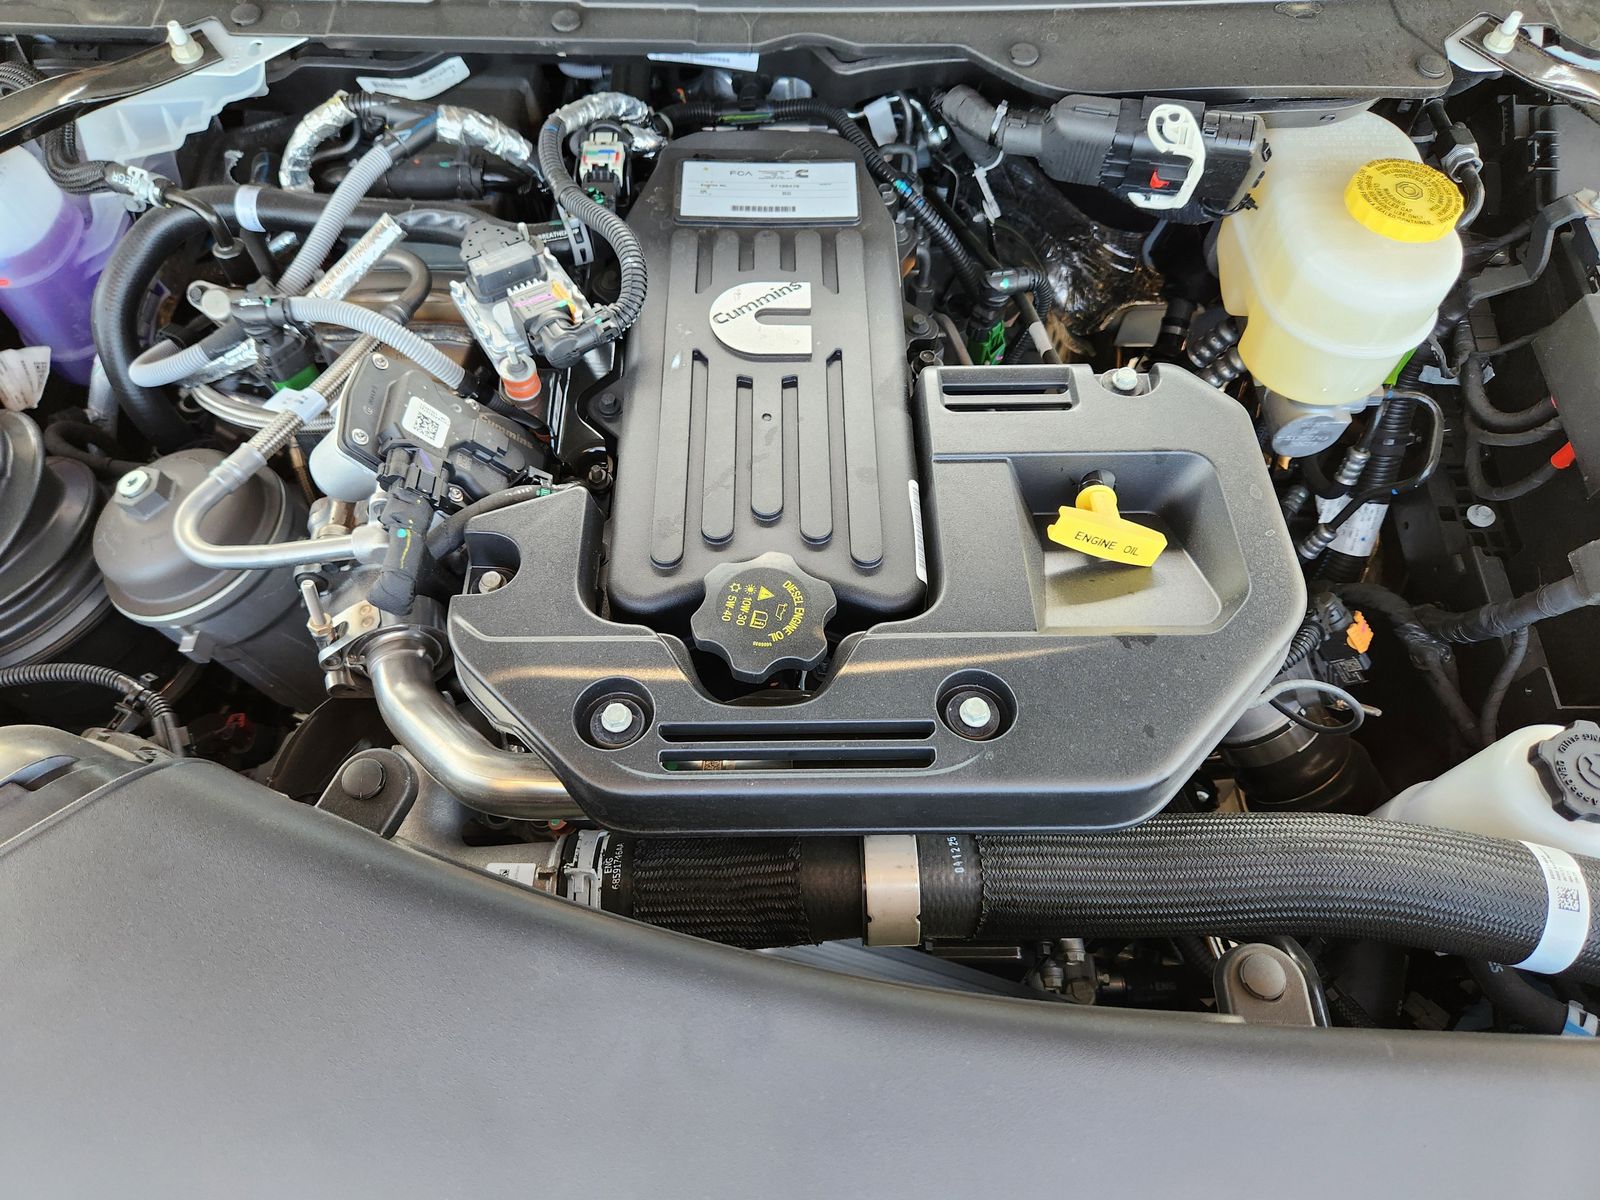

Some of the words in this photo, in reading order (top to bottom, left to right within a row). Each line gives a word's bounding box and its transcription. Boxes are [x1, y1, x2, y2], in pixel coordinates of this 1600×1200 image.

[712, 280, 803, 325] Cummins
[479, 414, 534, 449] Cummins
[1074, 530, 1118, 551] ENGINE
[1123, 545, 1139, 556] OIL
[782, 580, 805, 606] DIESEL
[721, 594, 737, 623] 5W-40
[735, 596, 753, 627] 10W-30
[782, 606, 806, 636] ENGINE
[768, 630, 784, 643] OIL
[603, 857, 614, 875] ENG
